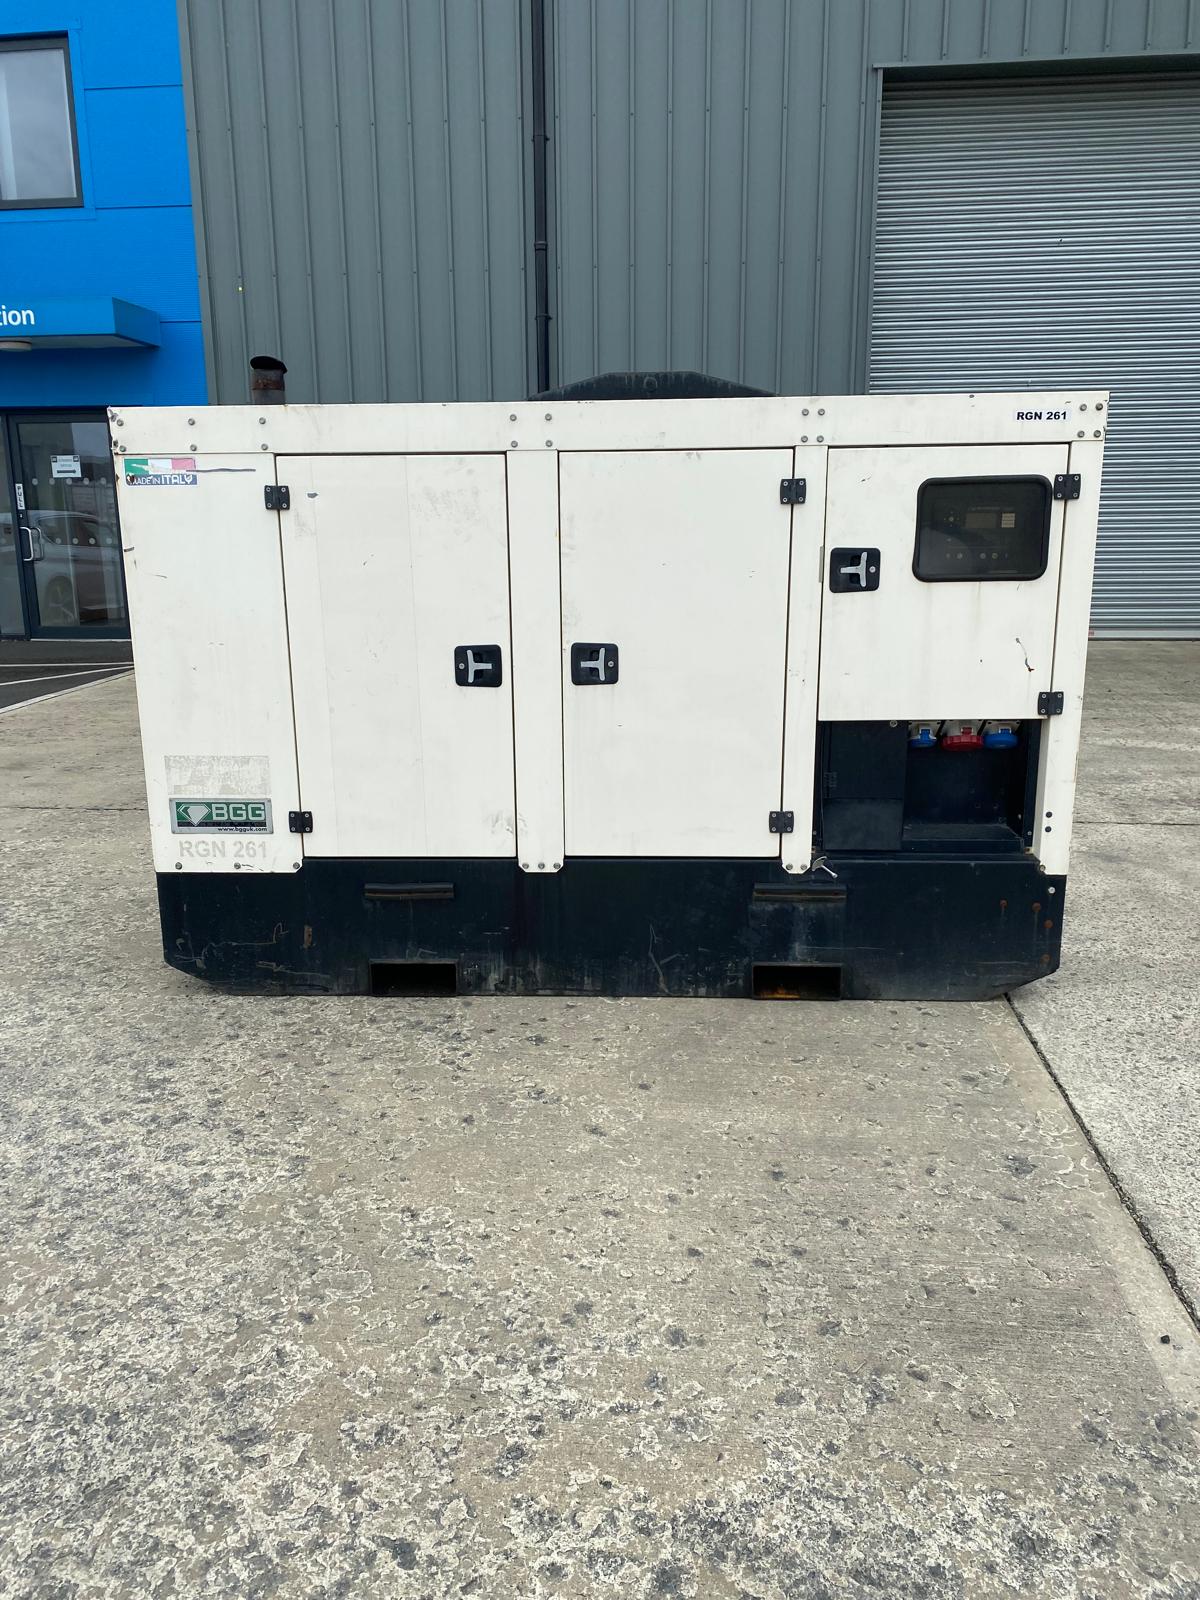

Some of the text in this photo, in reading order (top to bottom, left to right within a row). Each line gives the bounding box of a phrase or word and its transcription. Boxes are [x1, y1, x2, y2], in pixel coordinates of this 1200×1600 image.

[1017, 411, 1067, 420] RGN 261
[162, 475, 193, 485] ITALY
[211, 803, 266, 821] BGG
[179, 840, 267, 858] RGN 261
